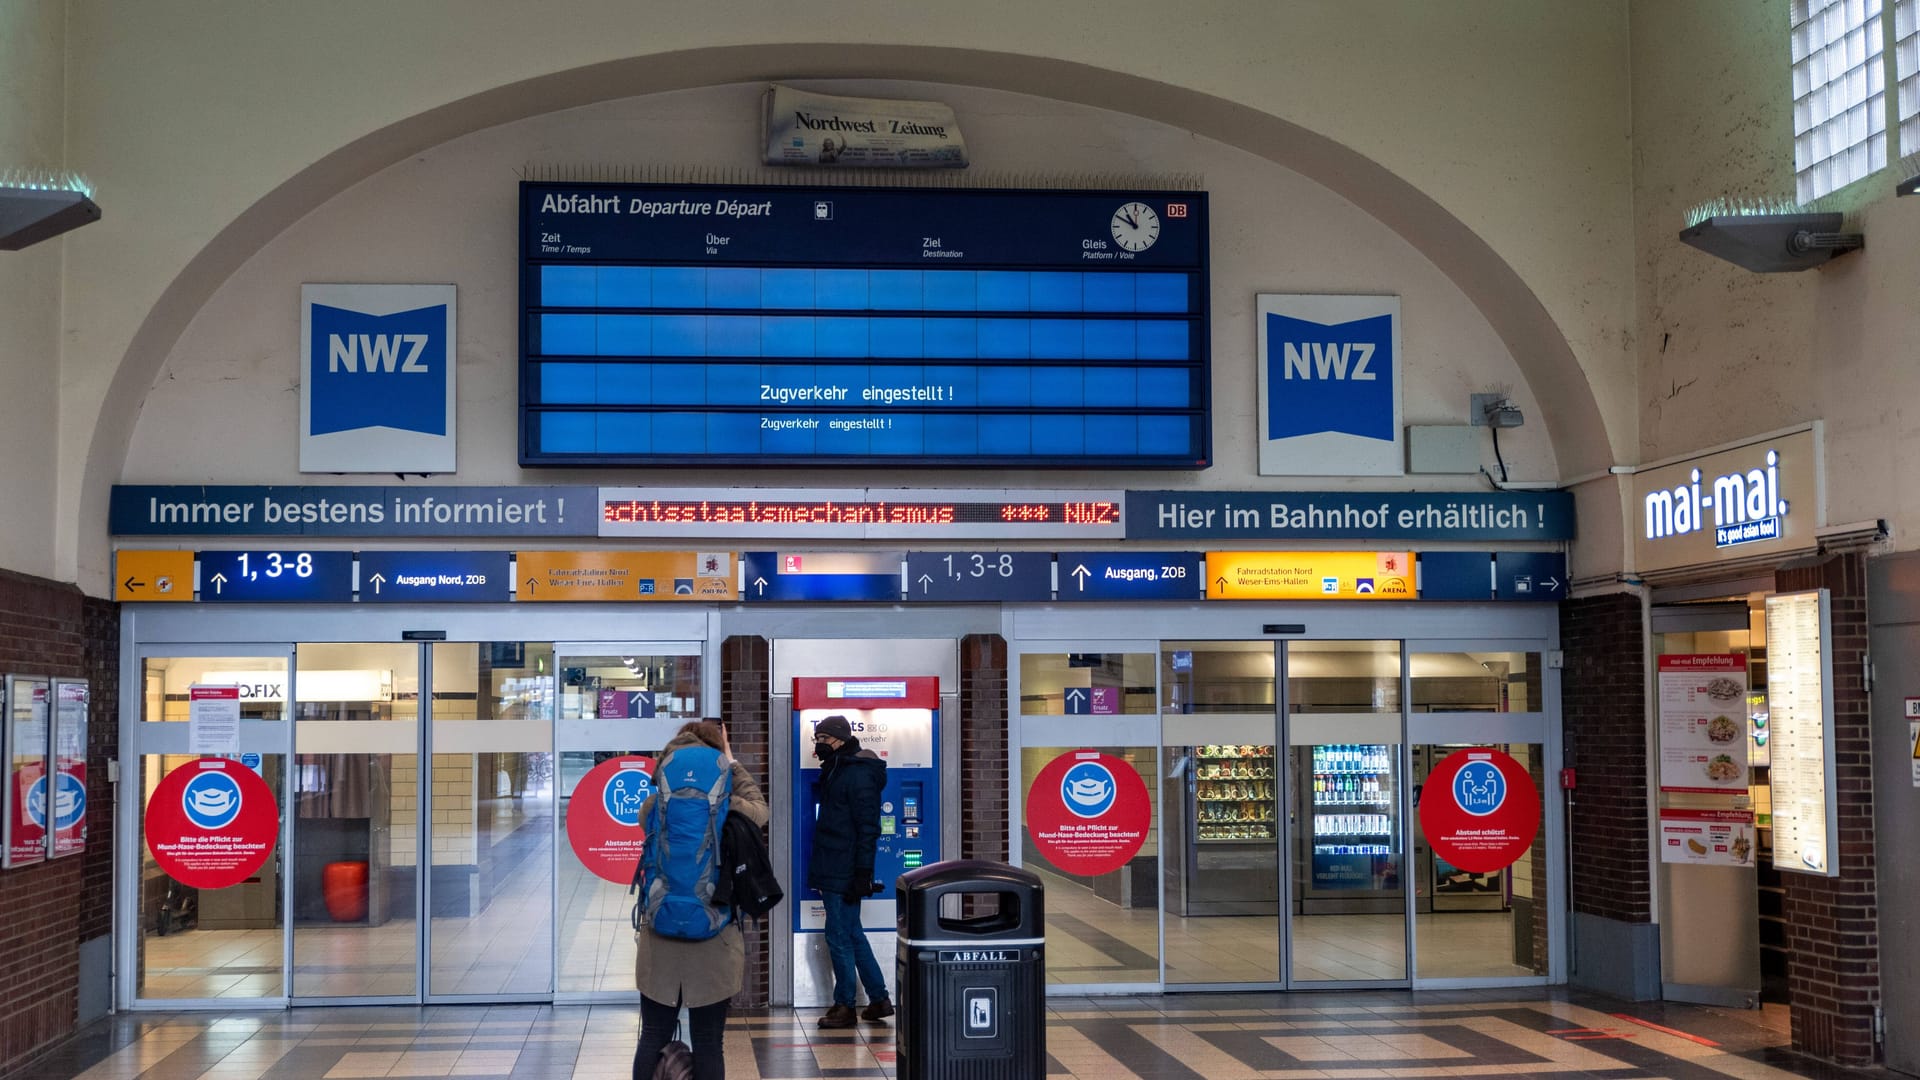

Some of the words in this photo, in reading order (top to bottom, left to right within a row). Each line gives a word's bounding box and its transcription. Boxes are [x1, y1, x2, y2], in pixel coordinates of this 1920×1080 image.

[795, 111, 876, 133] Nordwest
[888, 119, 947, 138] Zeitung
[541, 193, 620, 214] Abfahrt
[629, 198, 711, 217] Departure
[714, 200, 771, 218] Départ
[1169, 205, 1185, 216] DB
[541, 232, 561, 243] Zeit
[705, 232, 730, 245] Über
[923, 237, 941, 248] Ziel
[1082, 239, 1107, 249] Gleis
[541, 244, 560, 253] Time
[566, 245, 591, 255] Temps
[705, 247, 718, 255] Via
[922, 249, 963, 259] Destination
[1082, 251, 1113, 259] Platform
[1119, 251, 1135, 259] Voie
[329, 333, 428, 373] NWZ
[1284, 342, 1376, 381] NWZ
[760, 385, 848, 404] Zugverkehr
[862, 385, 943, 404] eingestellt
[949, 386, 953, 401] !
[760, 418, 820, 431] Zugverkehr
[829, 418, 885, 432] eingestellt
[150, 497, 254, 524] Immer
[264, 498, 384, 524] bestens
[395, 498, 547, 524] informiert
[557, 499, 565, 524] !
[1158, 503, 1216, 529] Hier
[1225, 503, 1260, 529] im
[1270, 503, 1390, 529] Bahnhof
[1398, 503, 1527, 529] erhältlich
[1537, 504, 1545, 529] !
[237, 553, 258, 582] 1,
[265, 552, 313, 578] 3-8
[942, 554, 962, 580] 1,
[969, 554, 1013, 578] 3-8
[1104, 566, 1158, 581] Ausgang,
[1161, 566, 1186, 579] ZOB
[1237, 567, 1292, 576] Fahrradstation
[1294, 567, 1313, 576] Nord
[396, 574, 437, 587] Ausgang
[438, 574, 464, 586] Nord,
[466, 575, 486, 585] ZOB
[1237, 577, 1309, 586] Weser-Ems-Hallen
[1692, 656, 1734, 667] Empfehlung
[953, 951, 1008, 962] ABFALL
